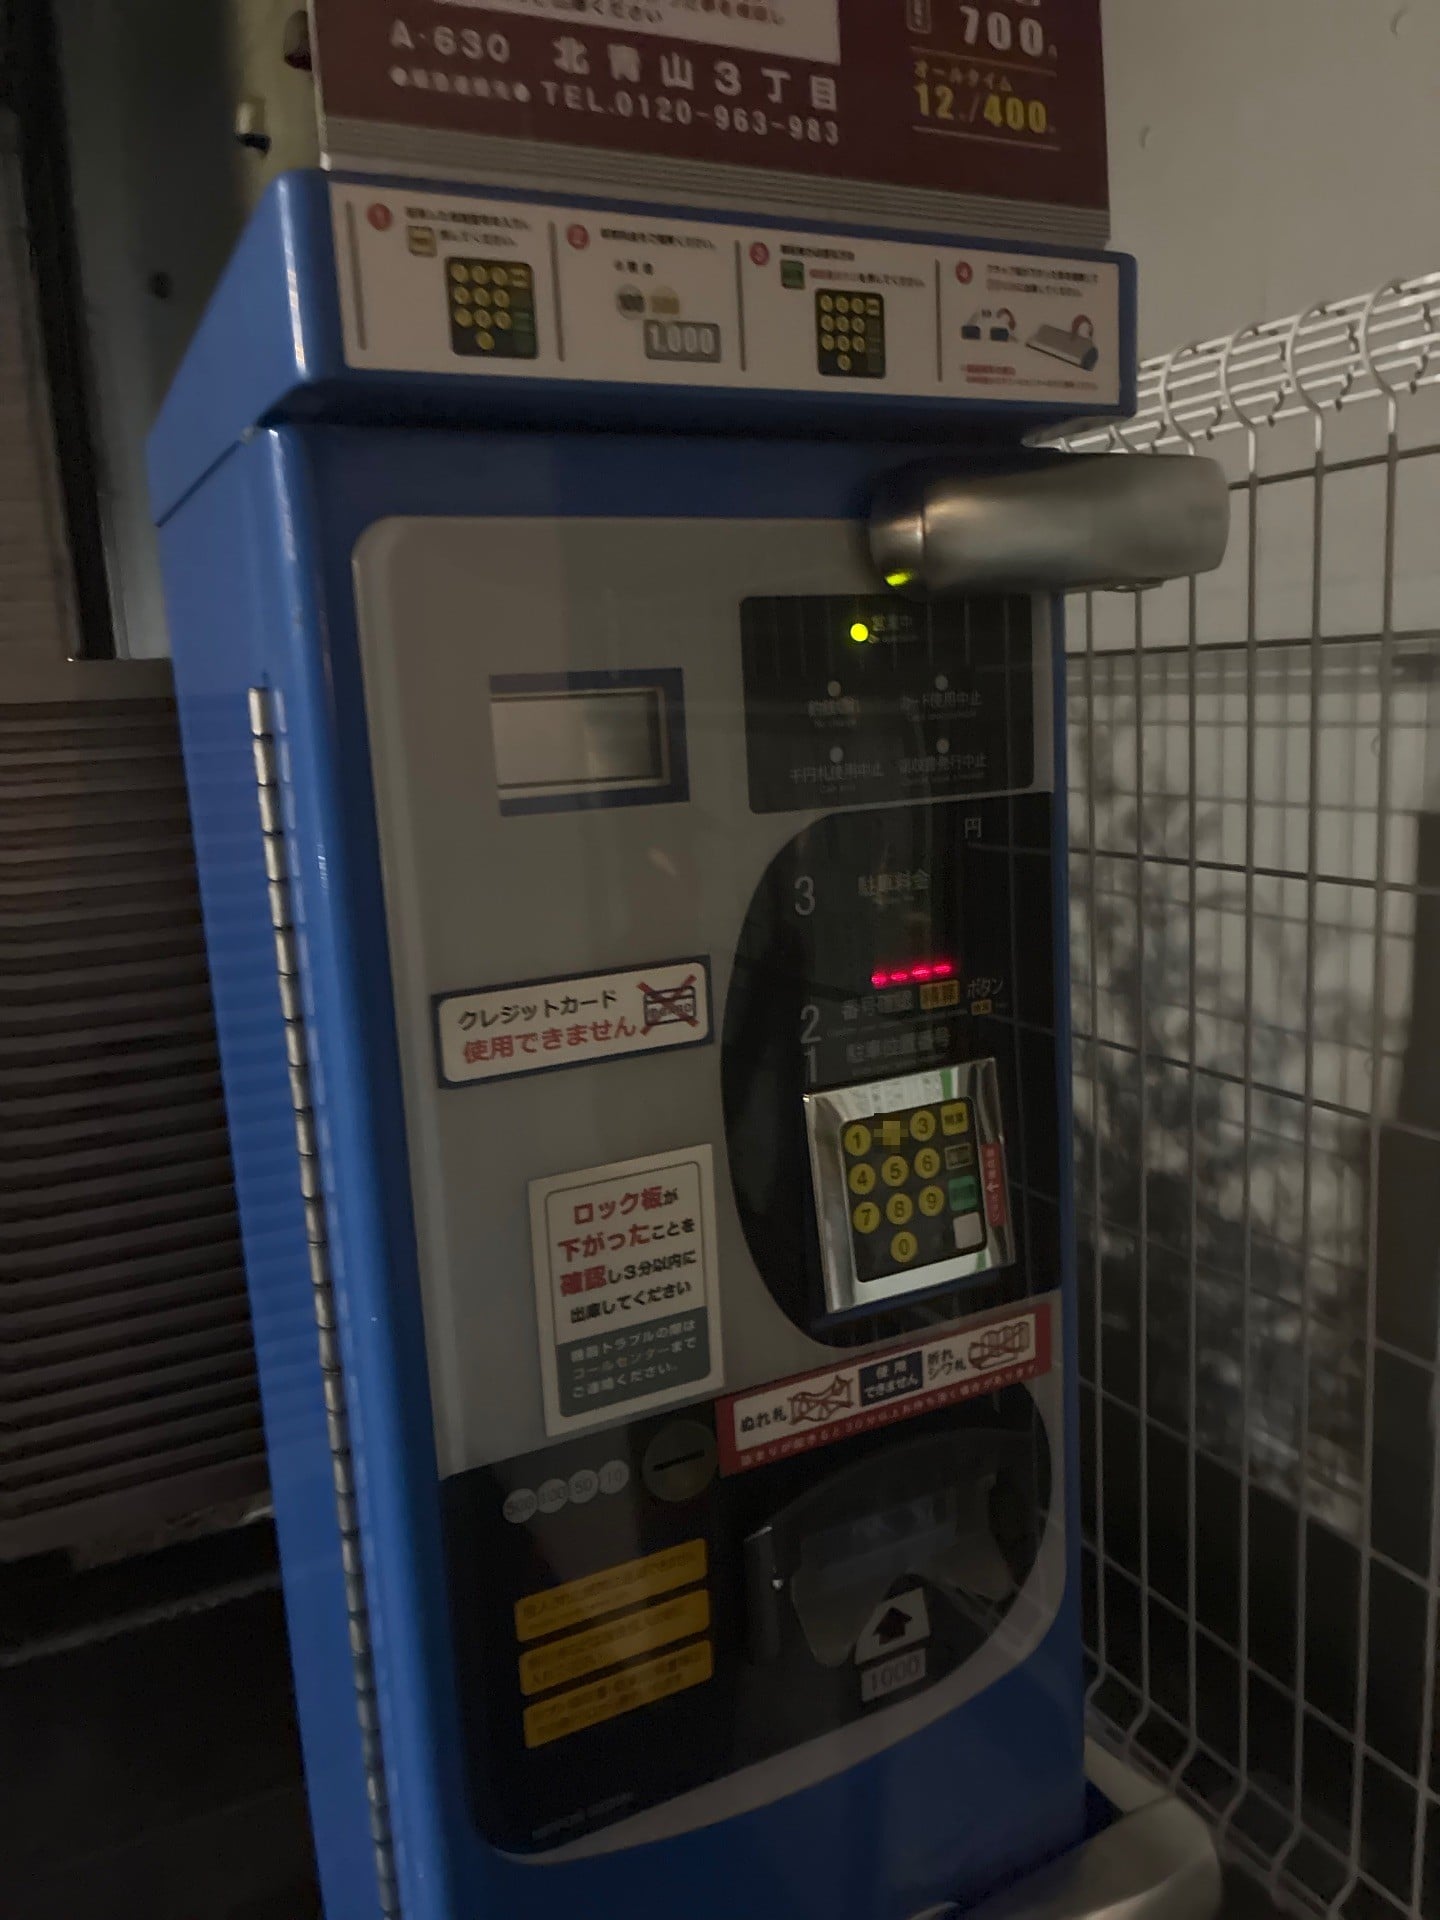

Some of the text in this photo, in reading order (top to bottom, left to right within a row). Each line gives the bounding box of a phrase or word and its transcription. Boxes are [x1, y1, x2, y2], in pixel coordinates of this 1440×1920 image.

[964, 817, 982, 839] 円
[794, 874, 816, 917] 3
[457, 989, 618, 1032] クレジットカード
[800, 1003, 822, 1045] 2
[463, 1016, 637, 1064] 使用できません
[803, 1044, 818, 1080] 1
[573, 1186, 679, 1225] ロック板が
[558, 1217, 697, 1263] 下がったことを
[570, 1280, 692, 1323] 出庫してください
